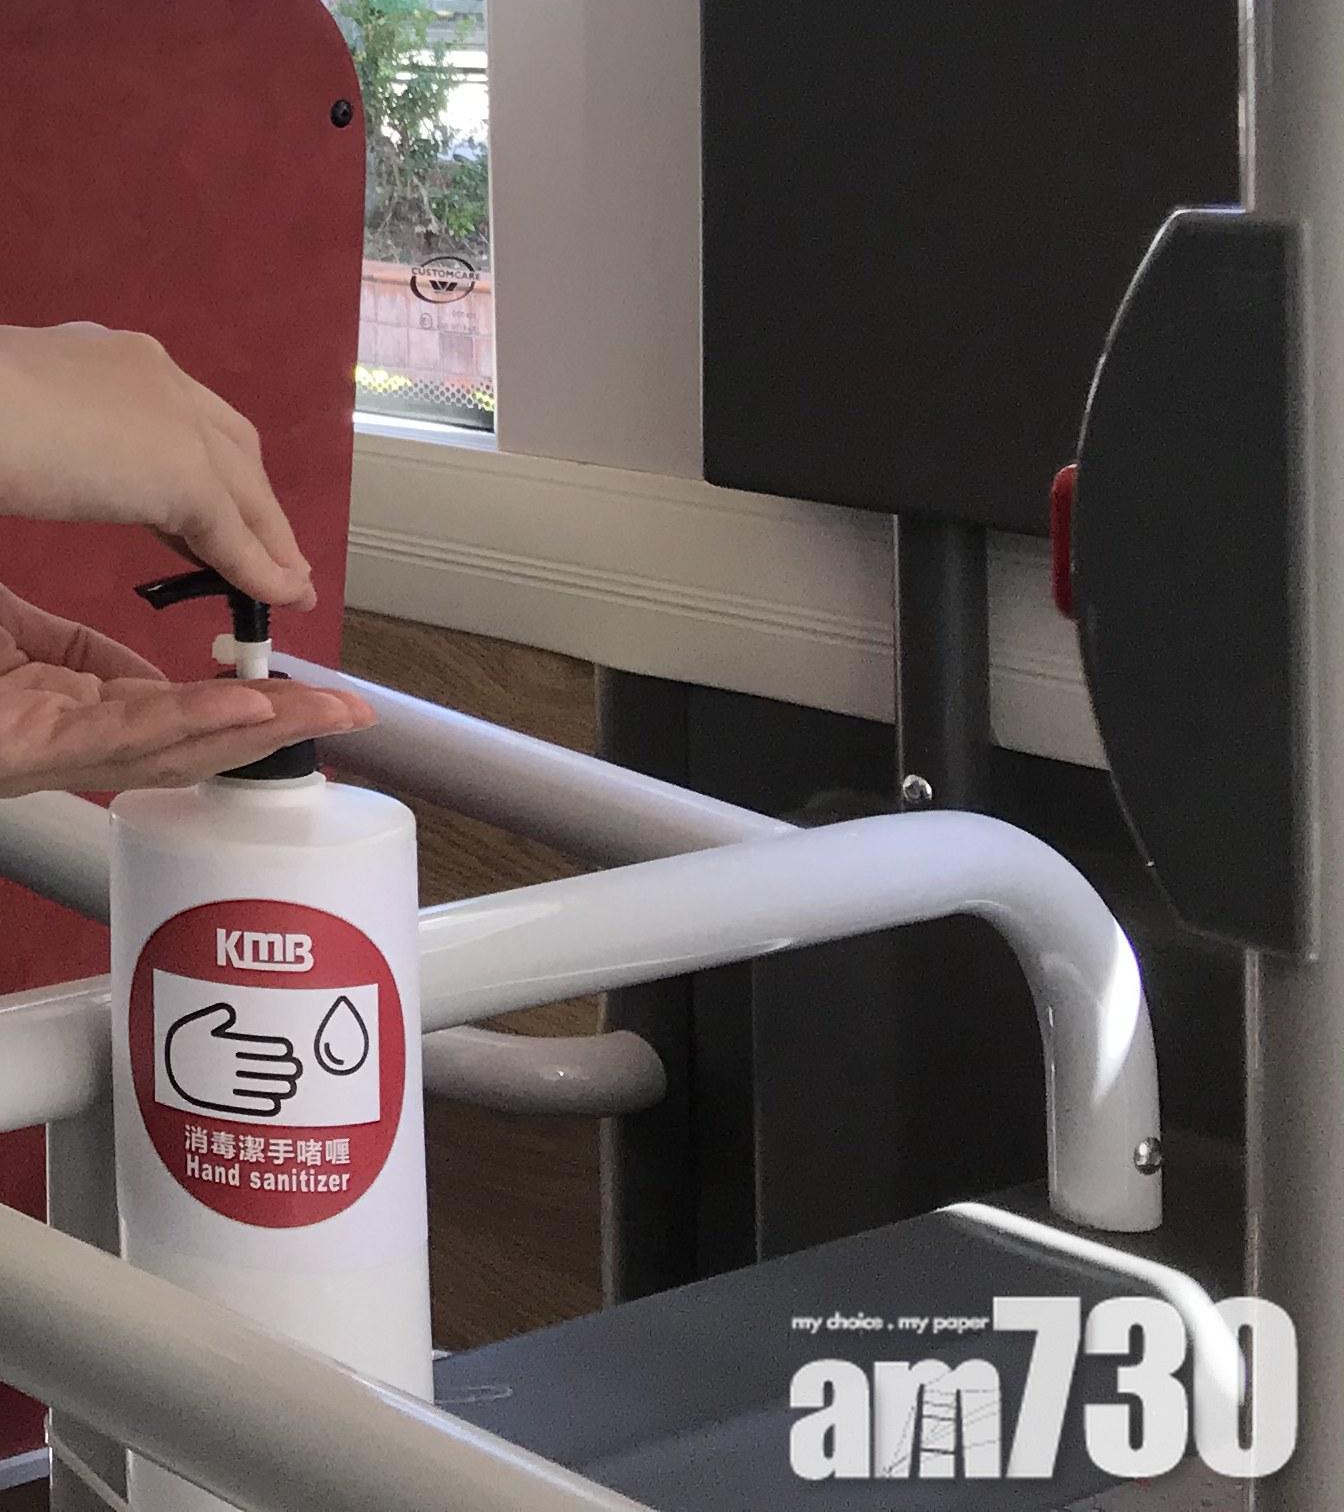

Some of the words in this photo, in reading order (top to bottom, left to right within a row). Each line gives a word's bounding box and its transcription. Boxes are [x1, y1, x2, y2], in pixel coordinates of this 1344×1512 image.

[411, 267, 481, 281] CUSTOMCARE
[216, 927, 315, 972] KMB
[184, 1124, 352, 1167] 消毒潔手啫喱
[186, 1154, 241, 1188] Hand
[249, 1167, 351, 1194] sanitizer
